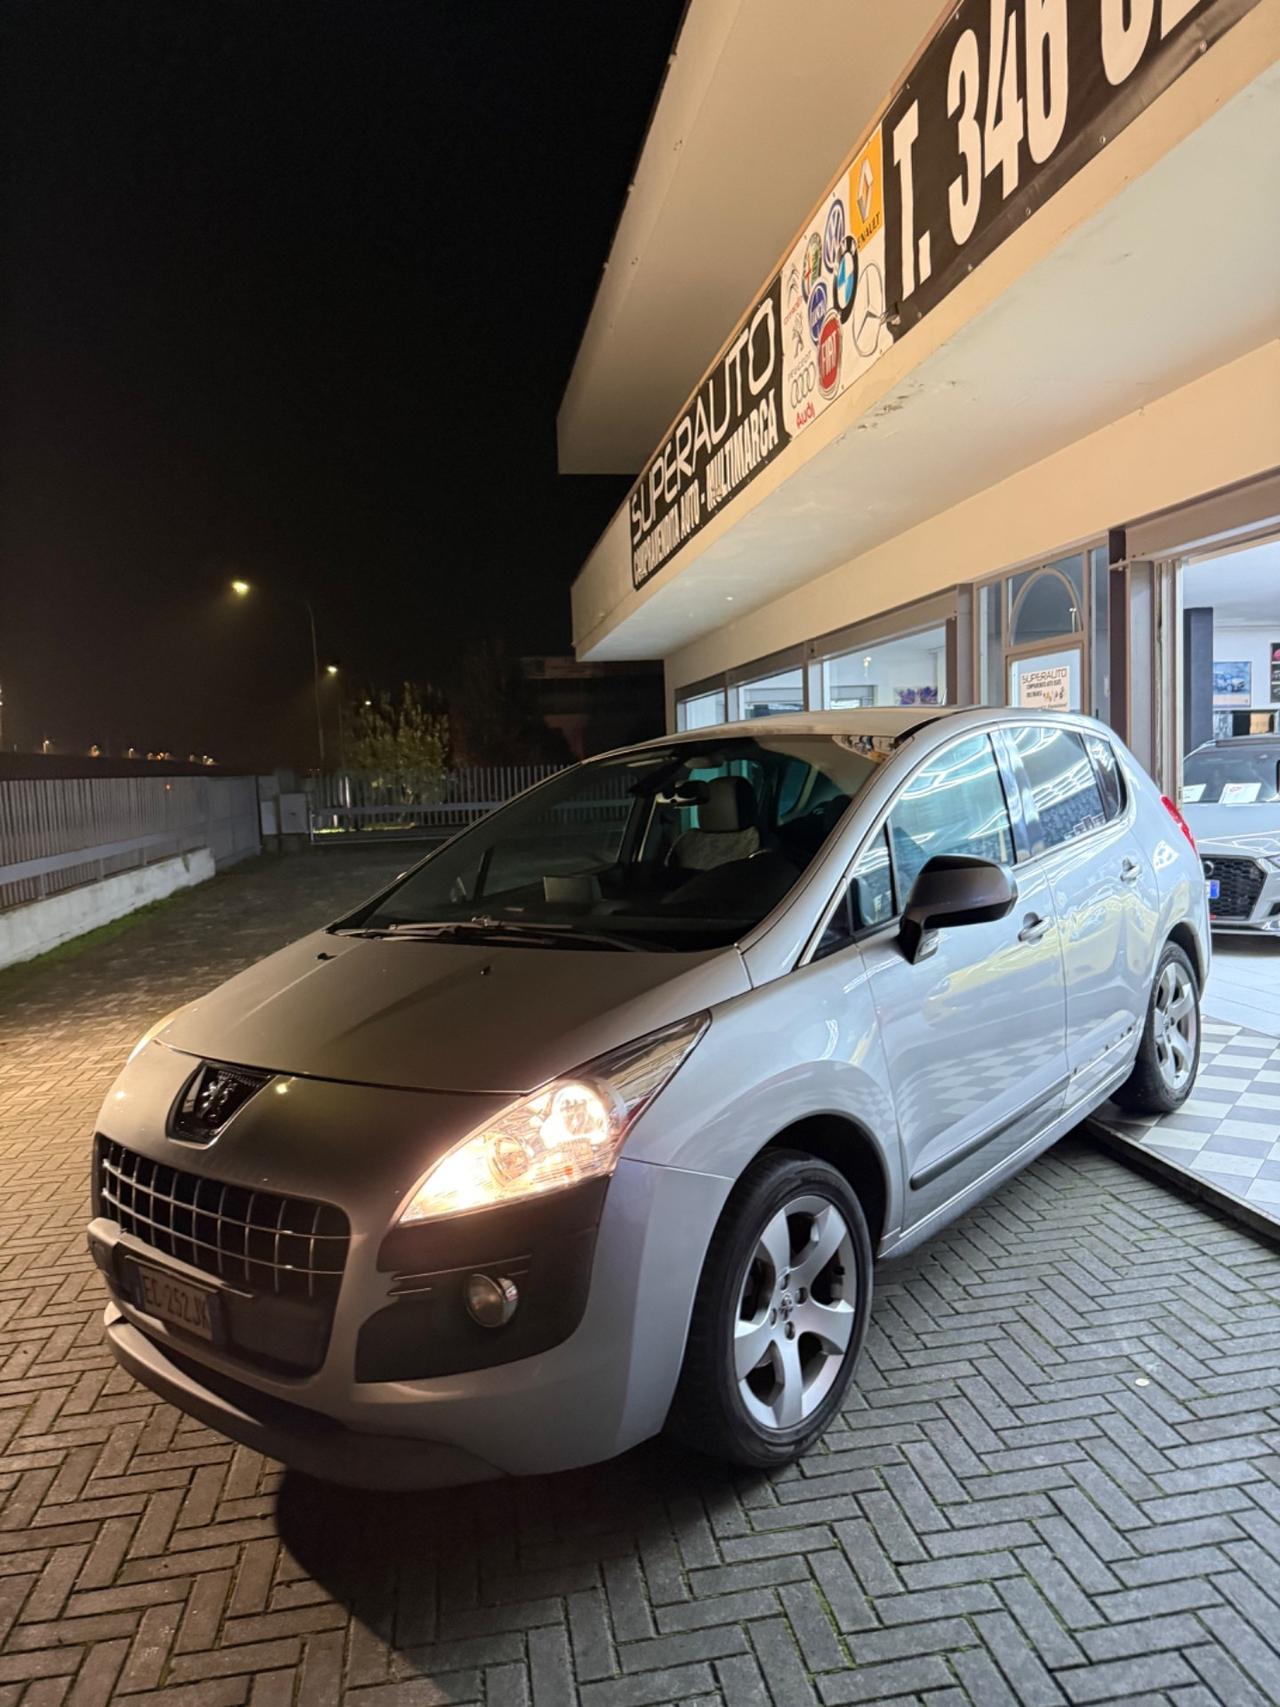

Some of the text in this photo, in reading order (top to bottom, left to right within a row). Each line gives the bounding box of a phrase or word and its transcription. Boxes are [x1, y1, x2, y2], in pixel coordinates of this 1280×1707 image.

[893, 0, 1068, 302] T. 346
[821, 330, 837, 377] FIAT
[631, 297, 775, 546] SUPERAUTO
[706, 387, 779, 512] MULTIMARCA
[796, 401, 816, 429] Audi
[1022, 668, 1067, 685] SUPERAUTO
